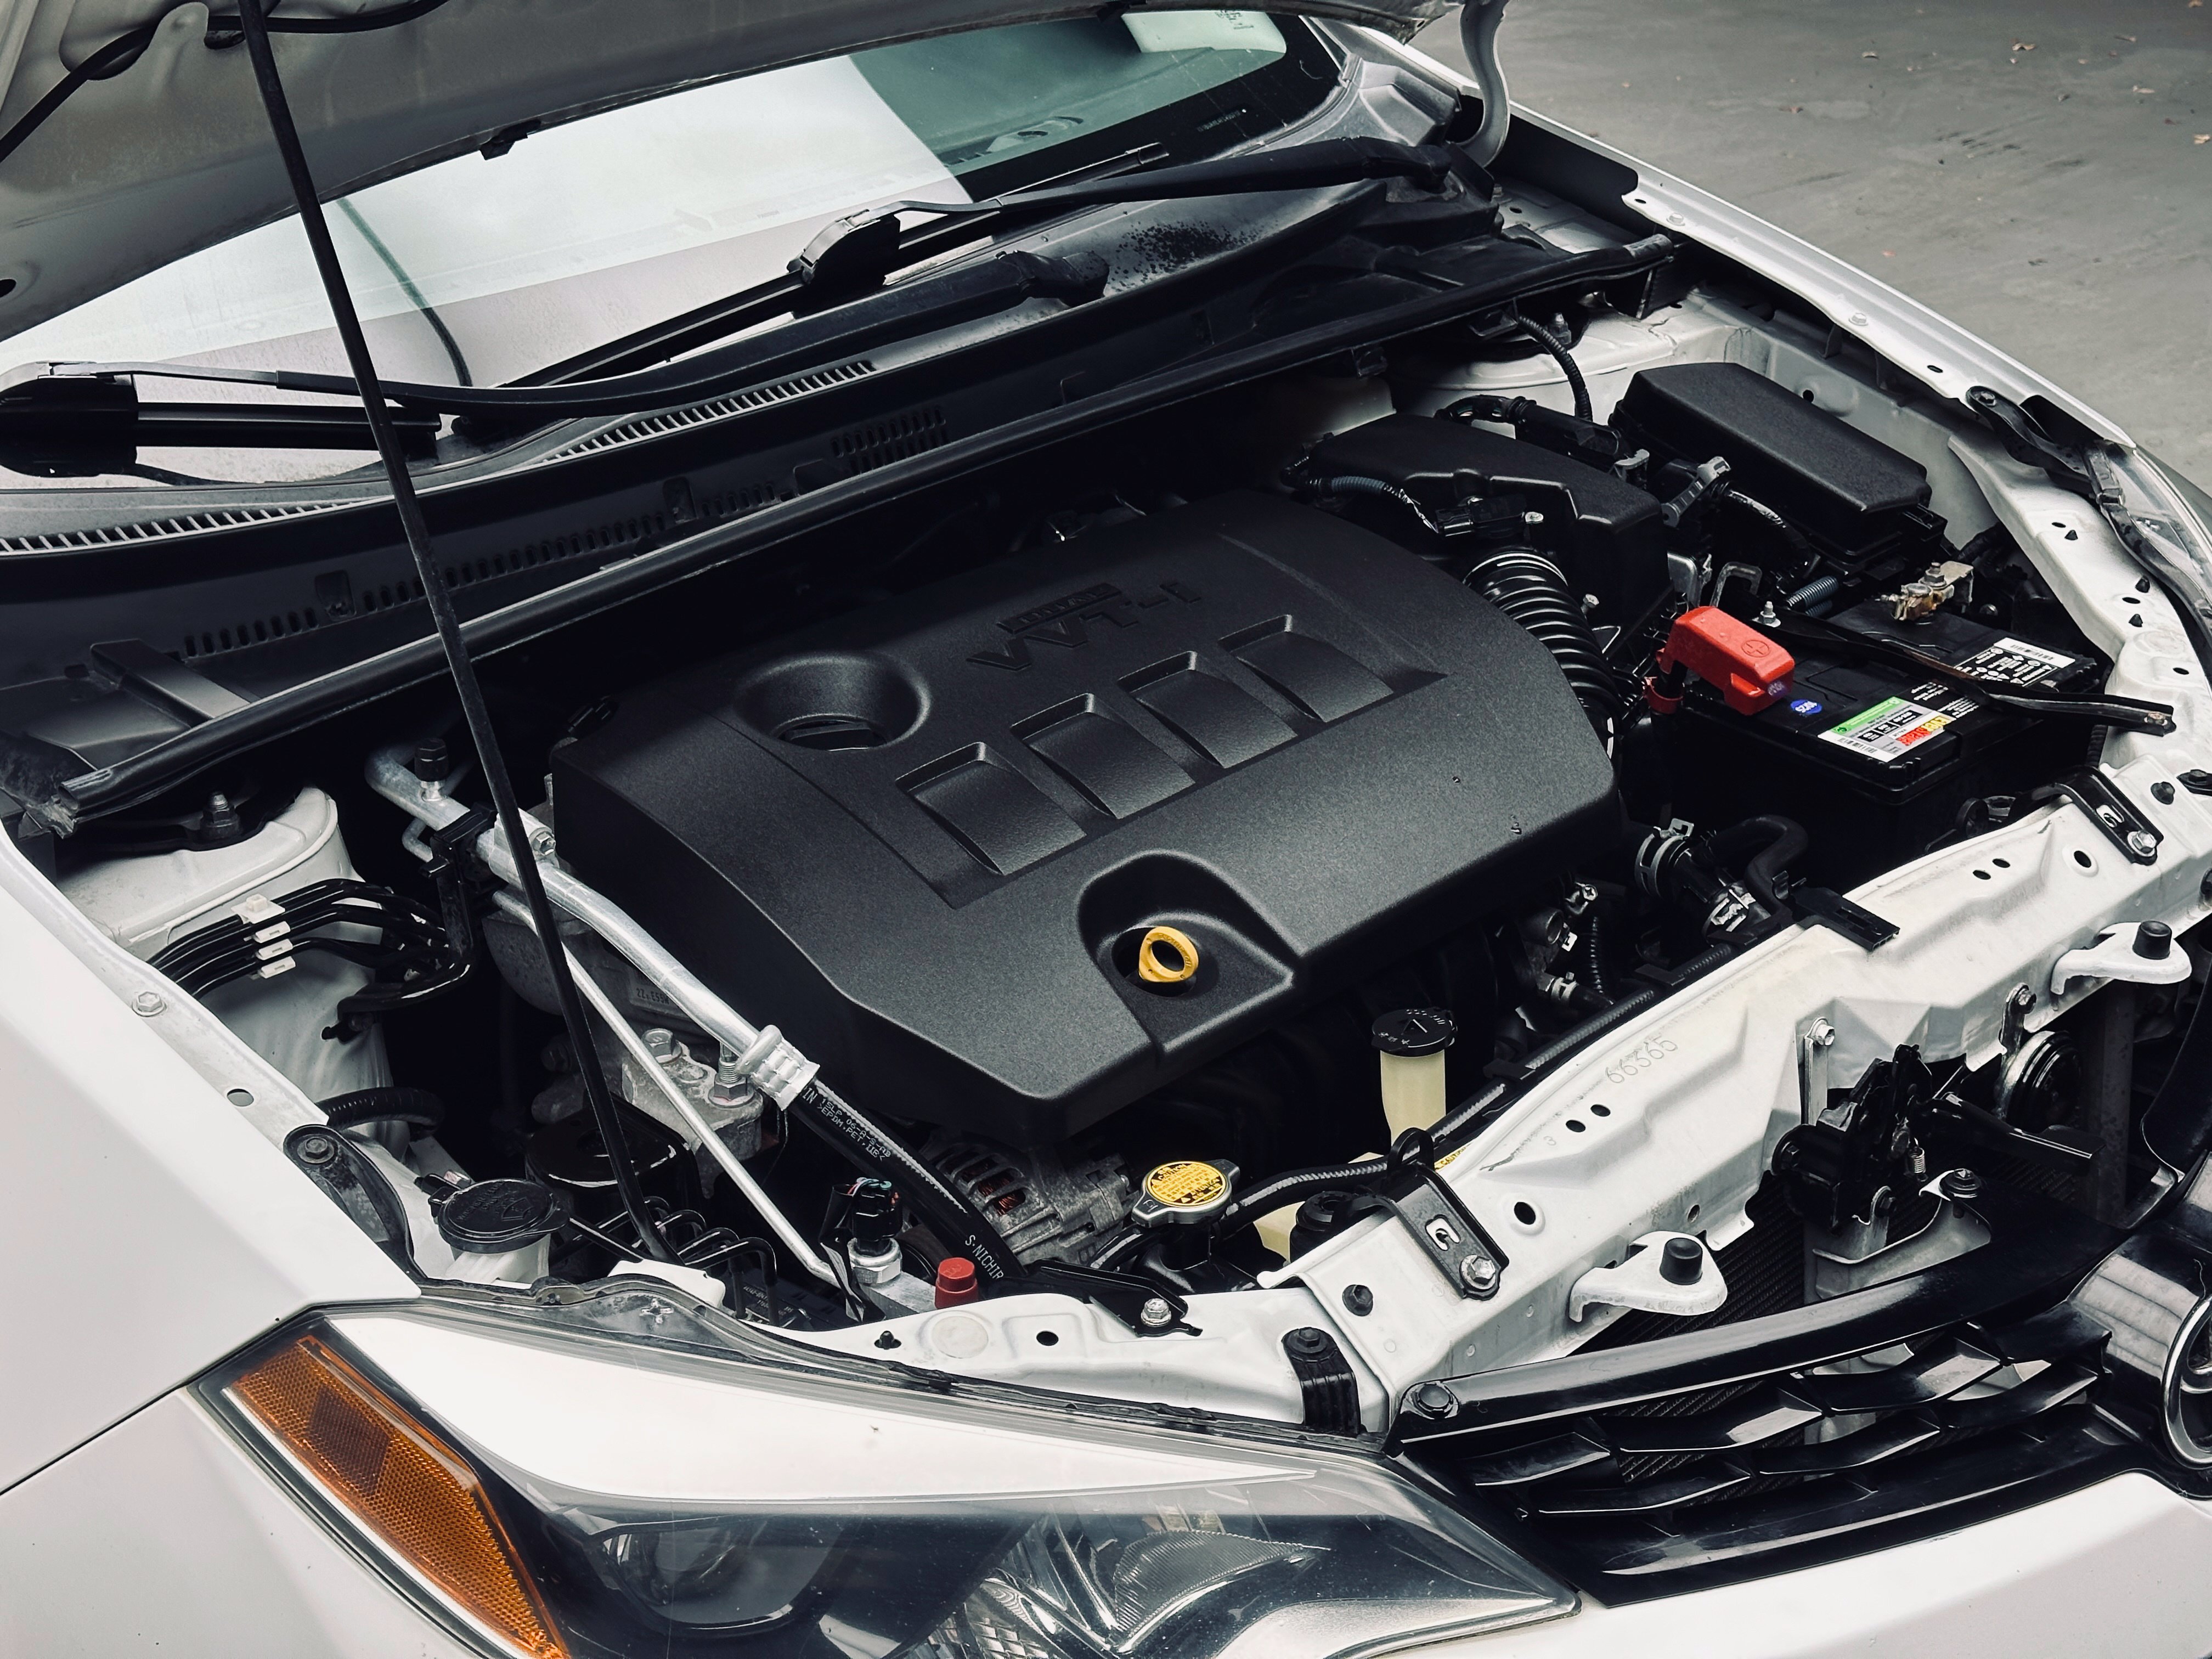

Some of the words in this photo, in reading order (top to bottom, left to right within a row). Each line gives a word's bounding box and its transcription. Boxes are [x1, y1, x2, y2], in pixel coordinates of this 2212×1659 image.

[1015, 586, 1105, 624] DUAL
[1604, 1035, 1678, 1084] 66365
[802, 1086, 818, 1104] IN
